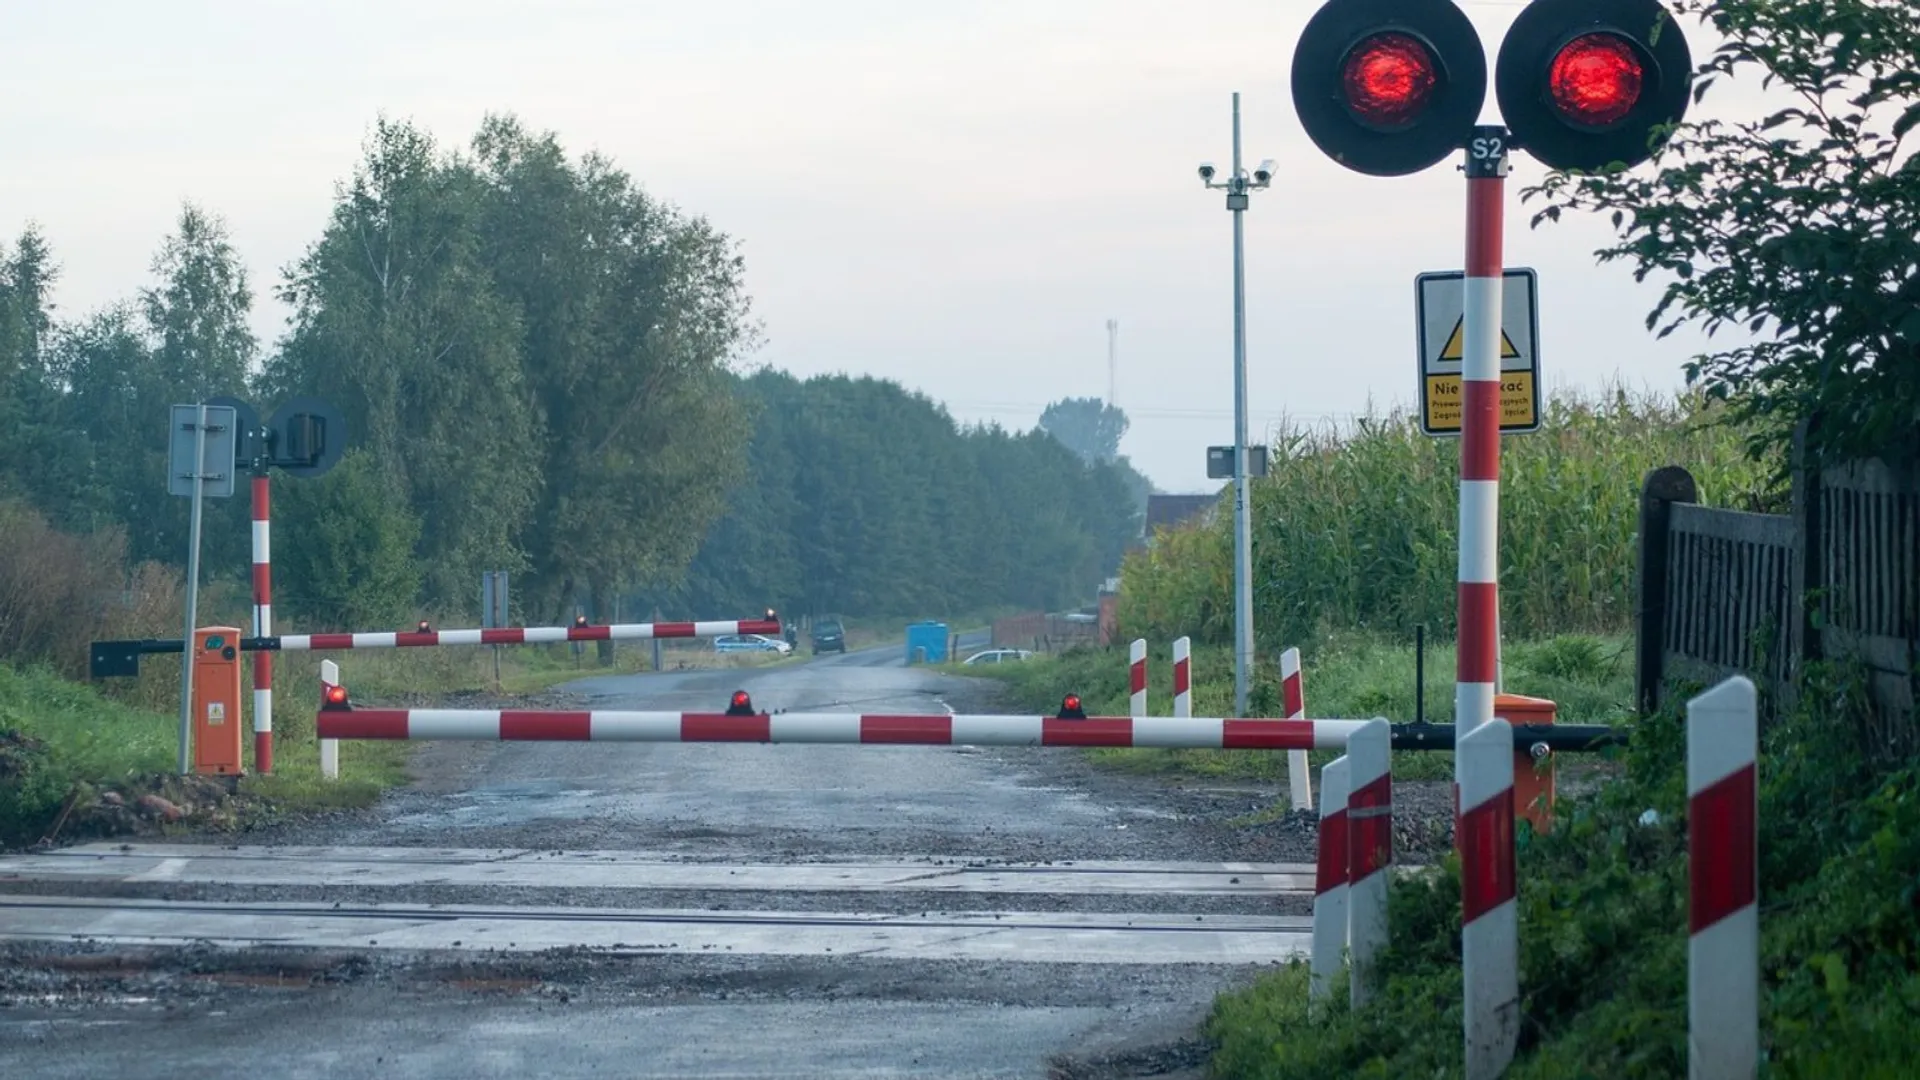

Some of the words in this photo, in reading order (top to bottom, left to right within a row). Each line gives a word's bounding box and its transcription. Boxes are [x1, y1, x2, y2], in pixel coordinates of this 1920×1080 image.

[1472, 137, 1502, 159] S2
[1435, 382, 1459, 395] Nie
[1500, 378, 1524, 392] kać
